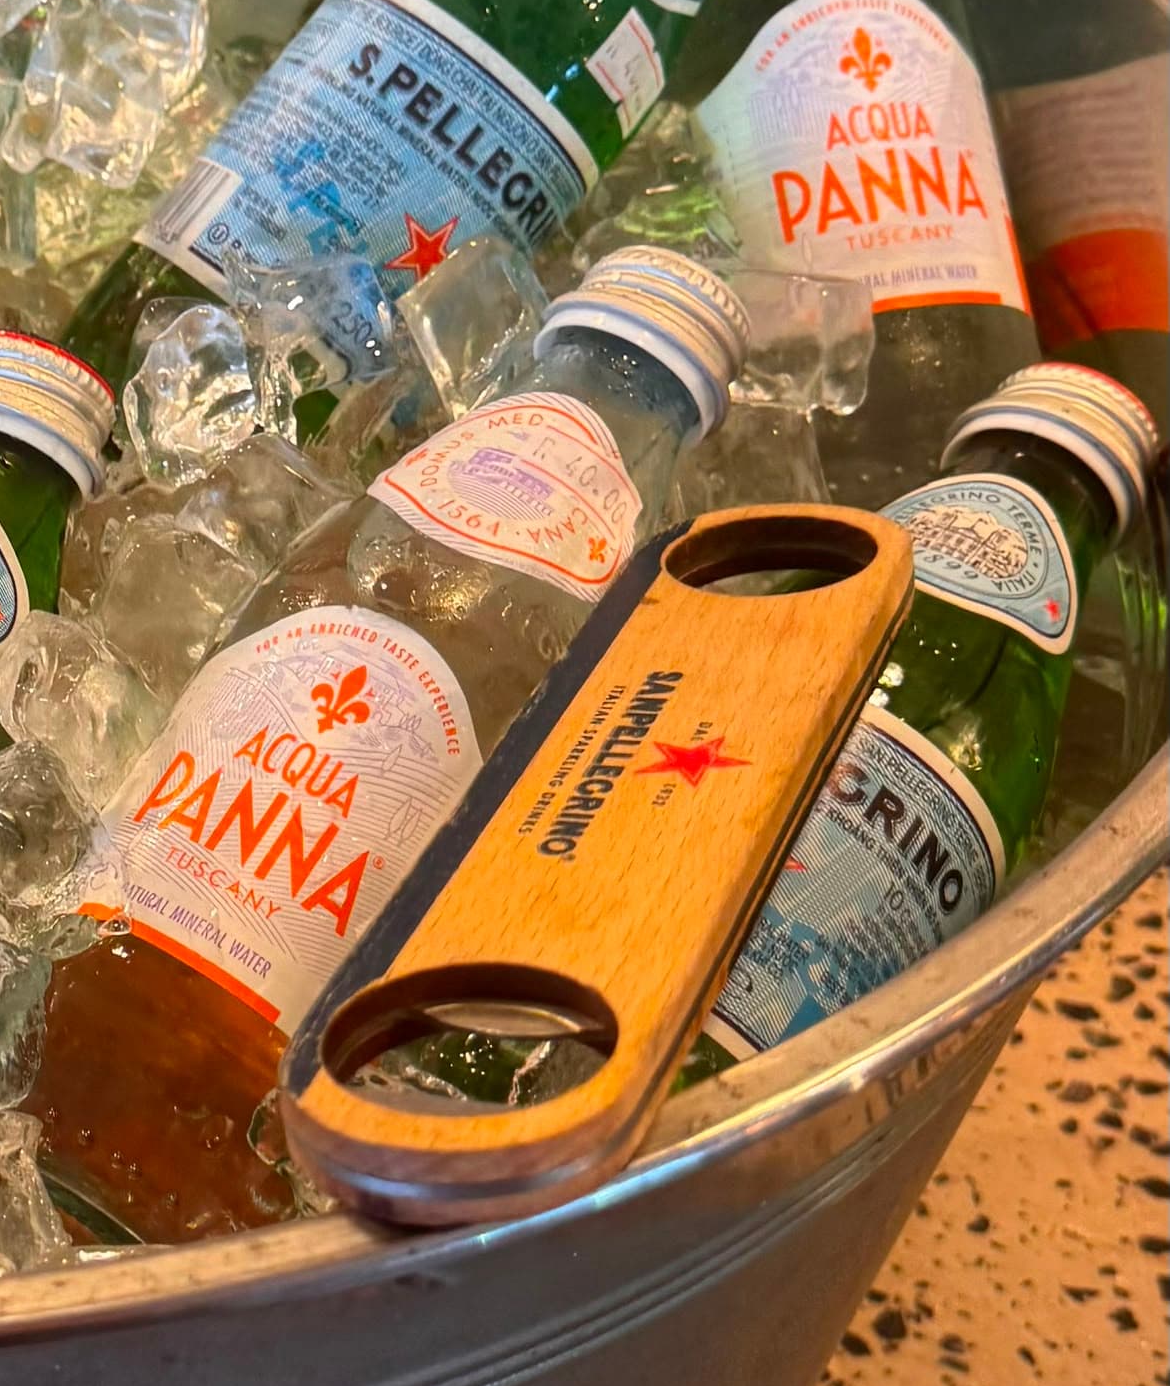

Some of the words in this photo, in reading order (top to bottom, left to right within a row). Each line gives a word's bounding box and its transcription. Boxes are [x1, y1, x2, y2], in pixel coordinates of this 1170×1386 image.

[827, 101, 935, 151] ACQUA
[771, 145, 988, 245] PANNA
[846, 223, 955, 251] TUSCANY
[890, 266, 944, 286] MINERAL
[945, 263, 979, 280] WATER
[420, 430, 475, 487] DOMUS
[487, 412, 545, 431] MED
[436, 498, 502, 537] 1564
[1006, 504, 1043, 557] TERME
[913, 549, 980, 580] 1899
[990, 569, 1037, 593] ITALIA
[256, 636, 279, 654] FOR
[286, 627, 303, 639] AN
[310, 623, 379, 644] ENRICHED
[382, 637, 420, 671] TASTE
[418, 670, 461, 755] EXPERIENCE
[590, 685, 627, 725] ITALIAN
[233, 725, 360, 819] ACQUA
[537, 670, 684, 856] SANPELLEGRINO
[549, 729, 598, 788] SPARKLING
[518, 791, 557, 834] DRINKS
[133, 749, 371, 939] PANNA
[165, 846, 282, 920] TUSCANY
[169, 904, 229, 950] MINERAL
[229, 938, 273, 979] WATER
